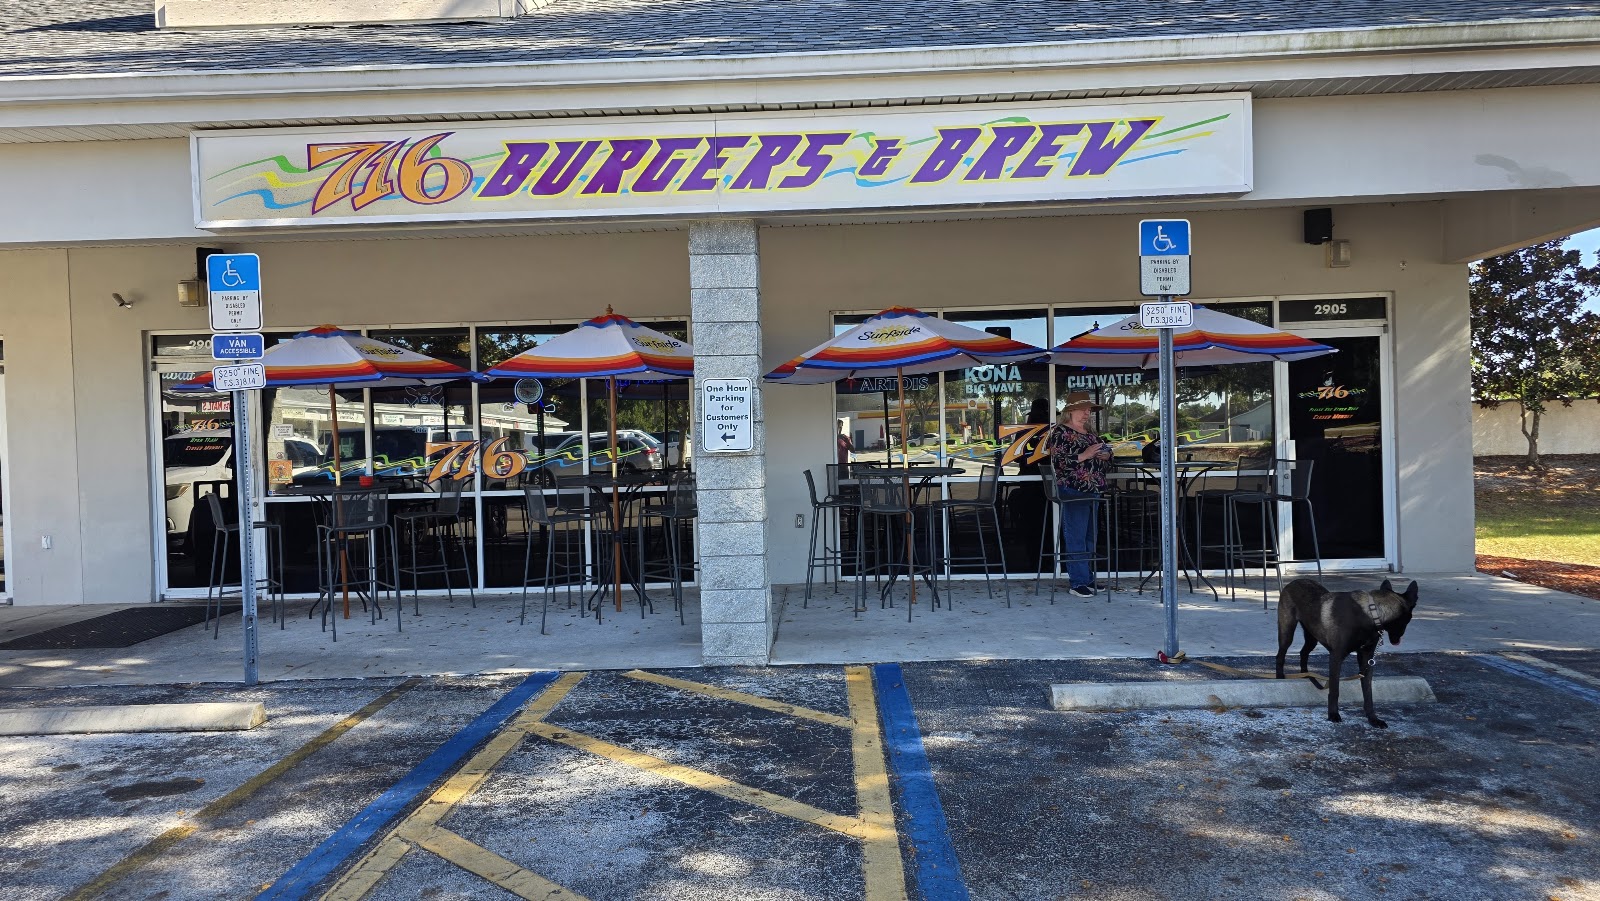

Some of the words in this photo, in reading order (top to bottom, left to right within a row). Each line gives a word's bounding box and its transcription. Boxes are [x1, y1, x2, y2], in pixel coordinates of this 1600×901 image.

[307, 132, 474, 215] 716
[476, 131, 857, 199] BURGERS
[856, 138, 904, 178] &
[907, 119, 1160, 184] BREW
[1170, 305, 1187, 314] FINE
[1314, 303, 1347, 315] 2905
[857, 325, 921, 341] Surfside
[188, 339, 213, 350] 290
[228, 339, 247, 348] VAN
[631, 336, 682, 350] Surfside
[219, 347, 257, 355] ACCESSIBLE
[243, 367, 259, 376] FINE
[964, 365, 1023, 383] KONA
[860, 376, 929, 391] ARTOIS
[1067, 372, 1143, 389] CUTWATER
[726, 384, 748, 392] Hour
[965, 383, 987, 394] BIG
[989, 382, 1023, 393] WAVE
[709, 394, 745, 403] Parking
[717, 423, 739, 431] Only
[998, 422, 1057, 467] 71
[425, 435, 528, 484] 716
